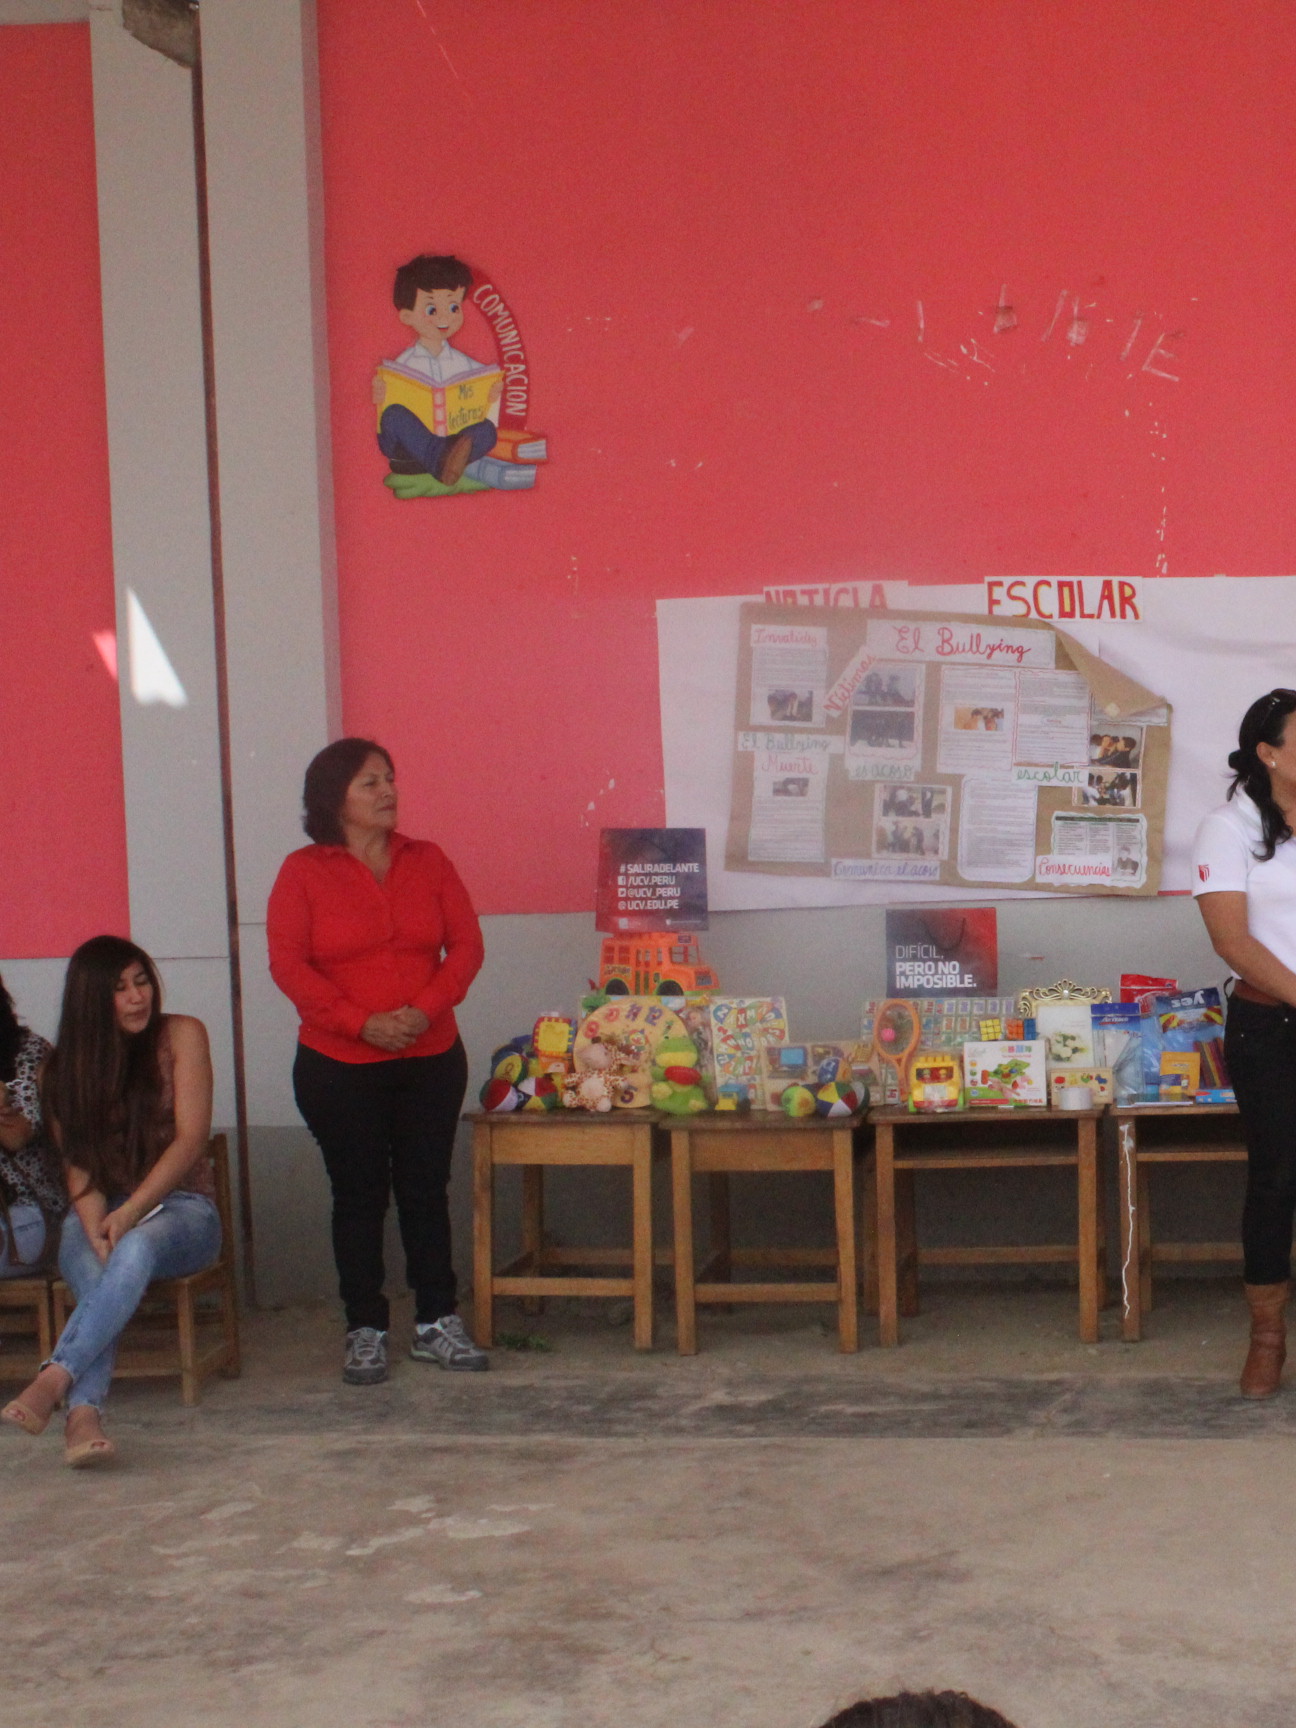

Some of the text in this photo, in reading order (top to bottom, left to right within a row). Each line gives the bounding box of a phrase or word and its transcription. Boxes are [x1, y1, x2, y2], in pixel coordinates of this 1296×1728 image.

[472, 284, 529, 417] COMUNICACION
[986, 579, 1141, 620] ESCOLAR
[892, 625, 1032, 664] El Bullying
[1016, 761, 1083, 784] escolar
[626, 863, 700, 874] SALIRADELANTE
[1038, 856, 1111, 877] Consecuencias
[627, 887, 681, 899] @UCV_PERU
[896, 961, 960, 976] PERO NO
[896, 974, 978, 989] IMPOSIBLE.
[1171, 990, 1206, 1009] yes
